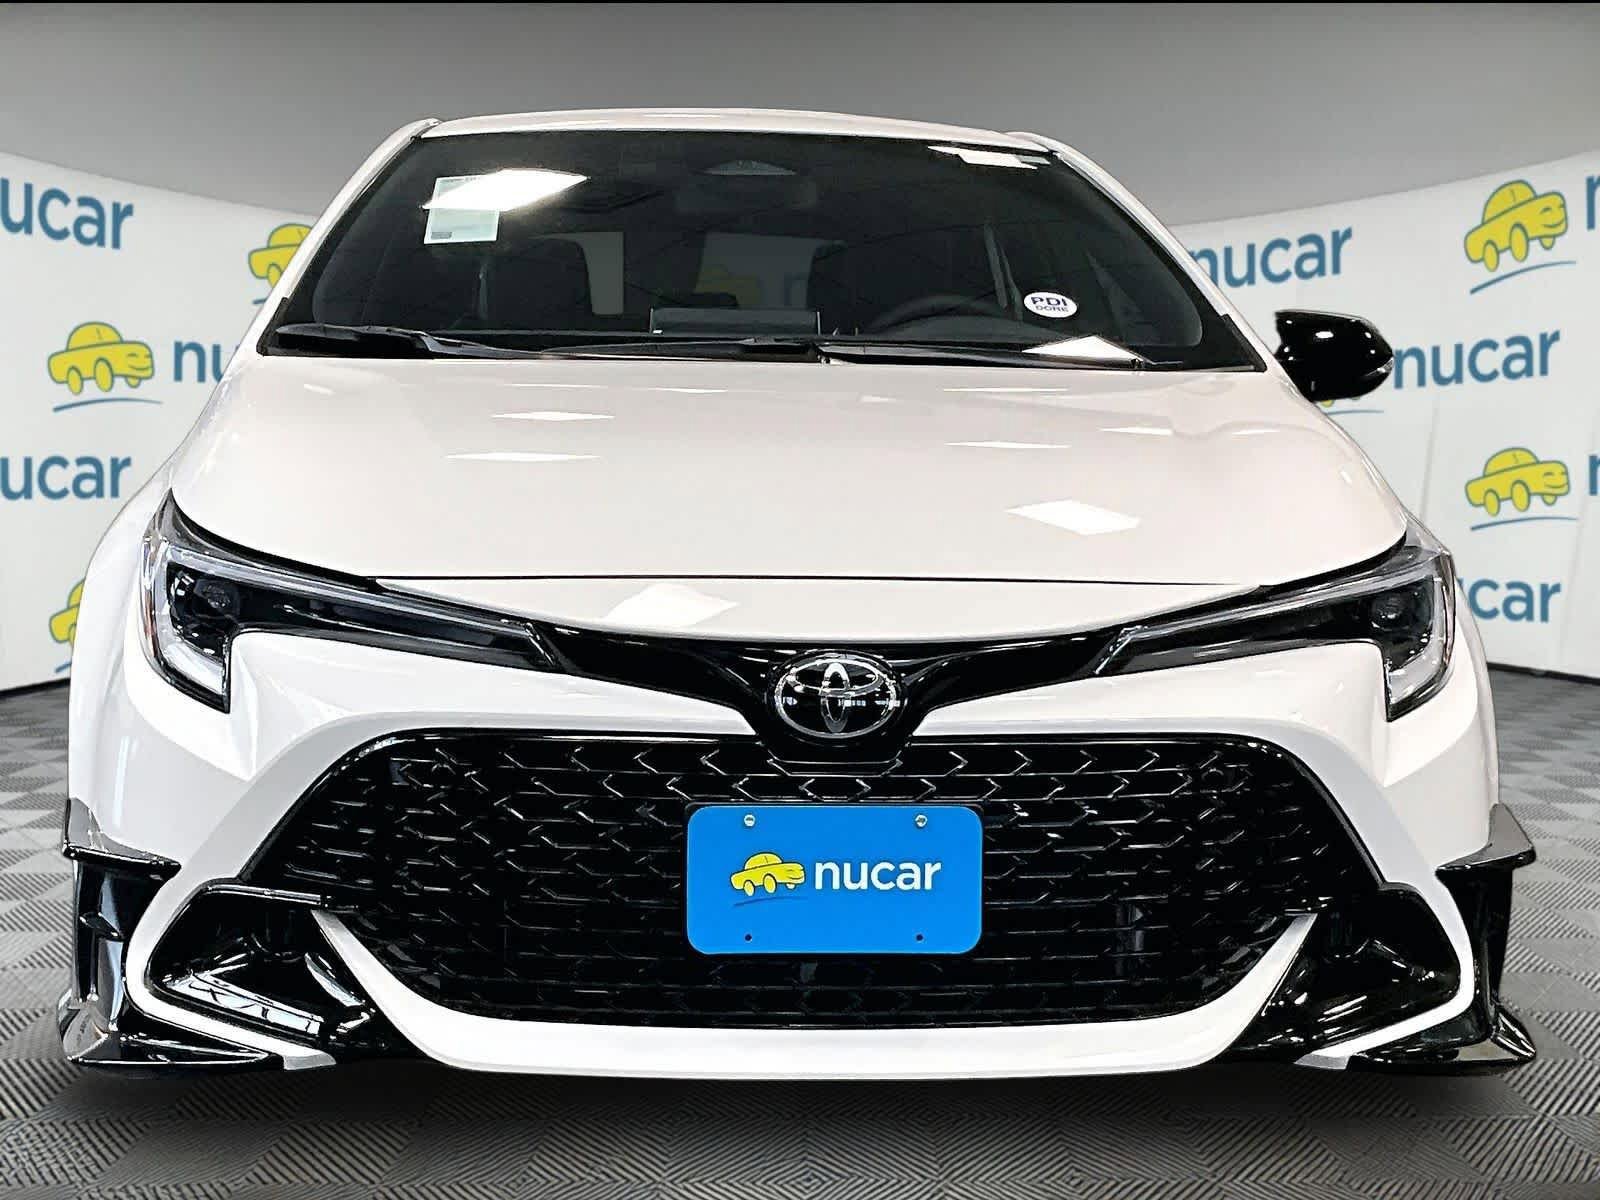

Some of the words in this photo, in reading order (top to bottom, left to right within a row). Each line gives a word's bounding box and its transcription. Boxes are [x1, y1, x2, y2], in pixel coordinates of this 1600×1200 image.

[1188, 227, 1353, 288] nucar
[1030, 296, 1068, 307] PDI
[1394, 329, 1560, 389] nucar
[1457, 578, 1561, 623] car
[814, 860, 942, 891] nucar
